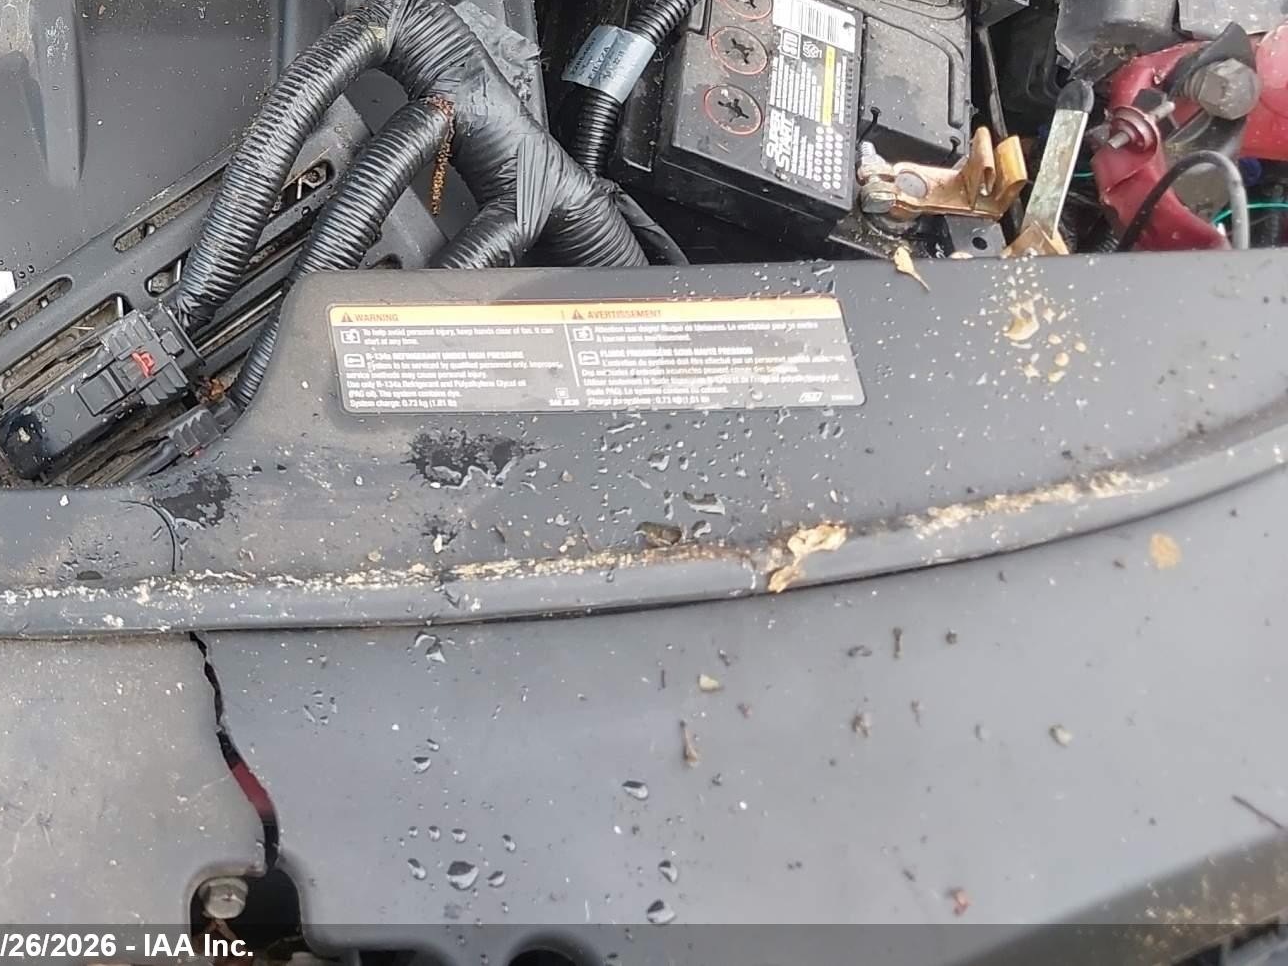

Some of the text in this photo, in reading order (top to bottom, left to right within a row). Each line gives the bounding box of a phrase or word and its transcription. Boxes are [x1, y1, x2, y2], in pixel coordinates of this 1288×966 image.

[775, 110, 794, 172] START
[355, 314, 399, 322] WARNING
[587, 310, 661, 319] AVERTISSEMENT
